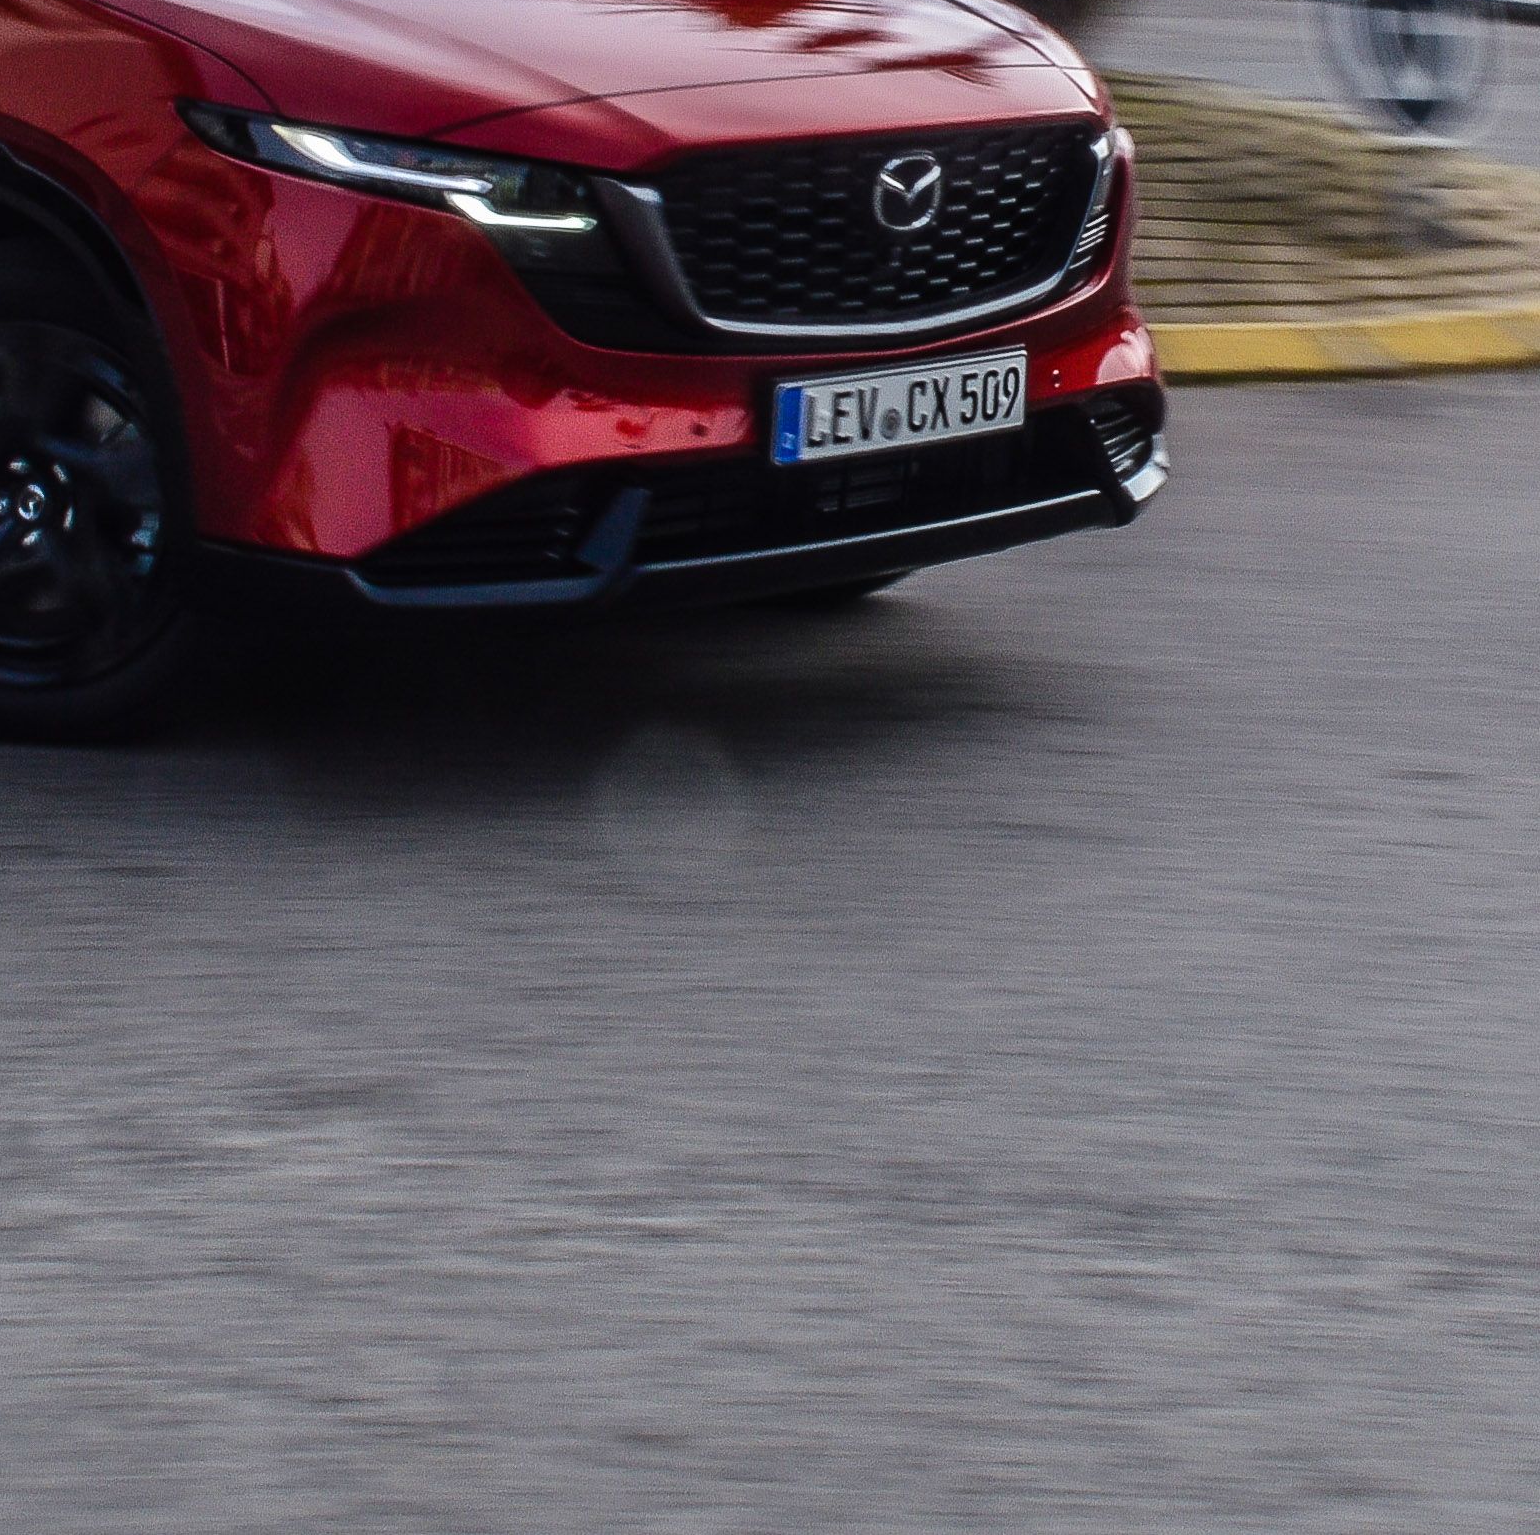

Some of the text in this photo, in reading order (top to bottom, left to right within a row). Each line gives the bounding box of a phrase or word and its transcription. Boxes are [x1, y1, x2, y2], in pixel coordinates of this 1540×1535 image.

[806, 366, 1021, 447] LEV CX 509
